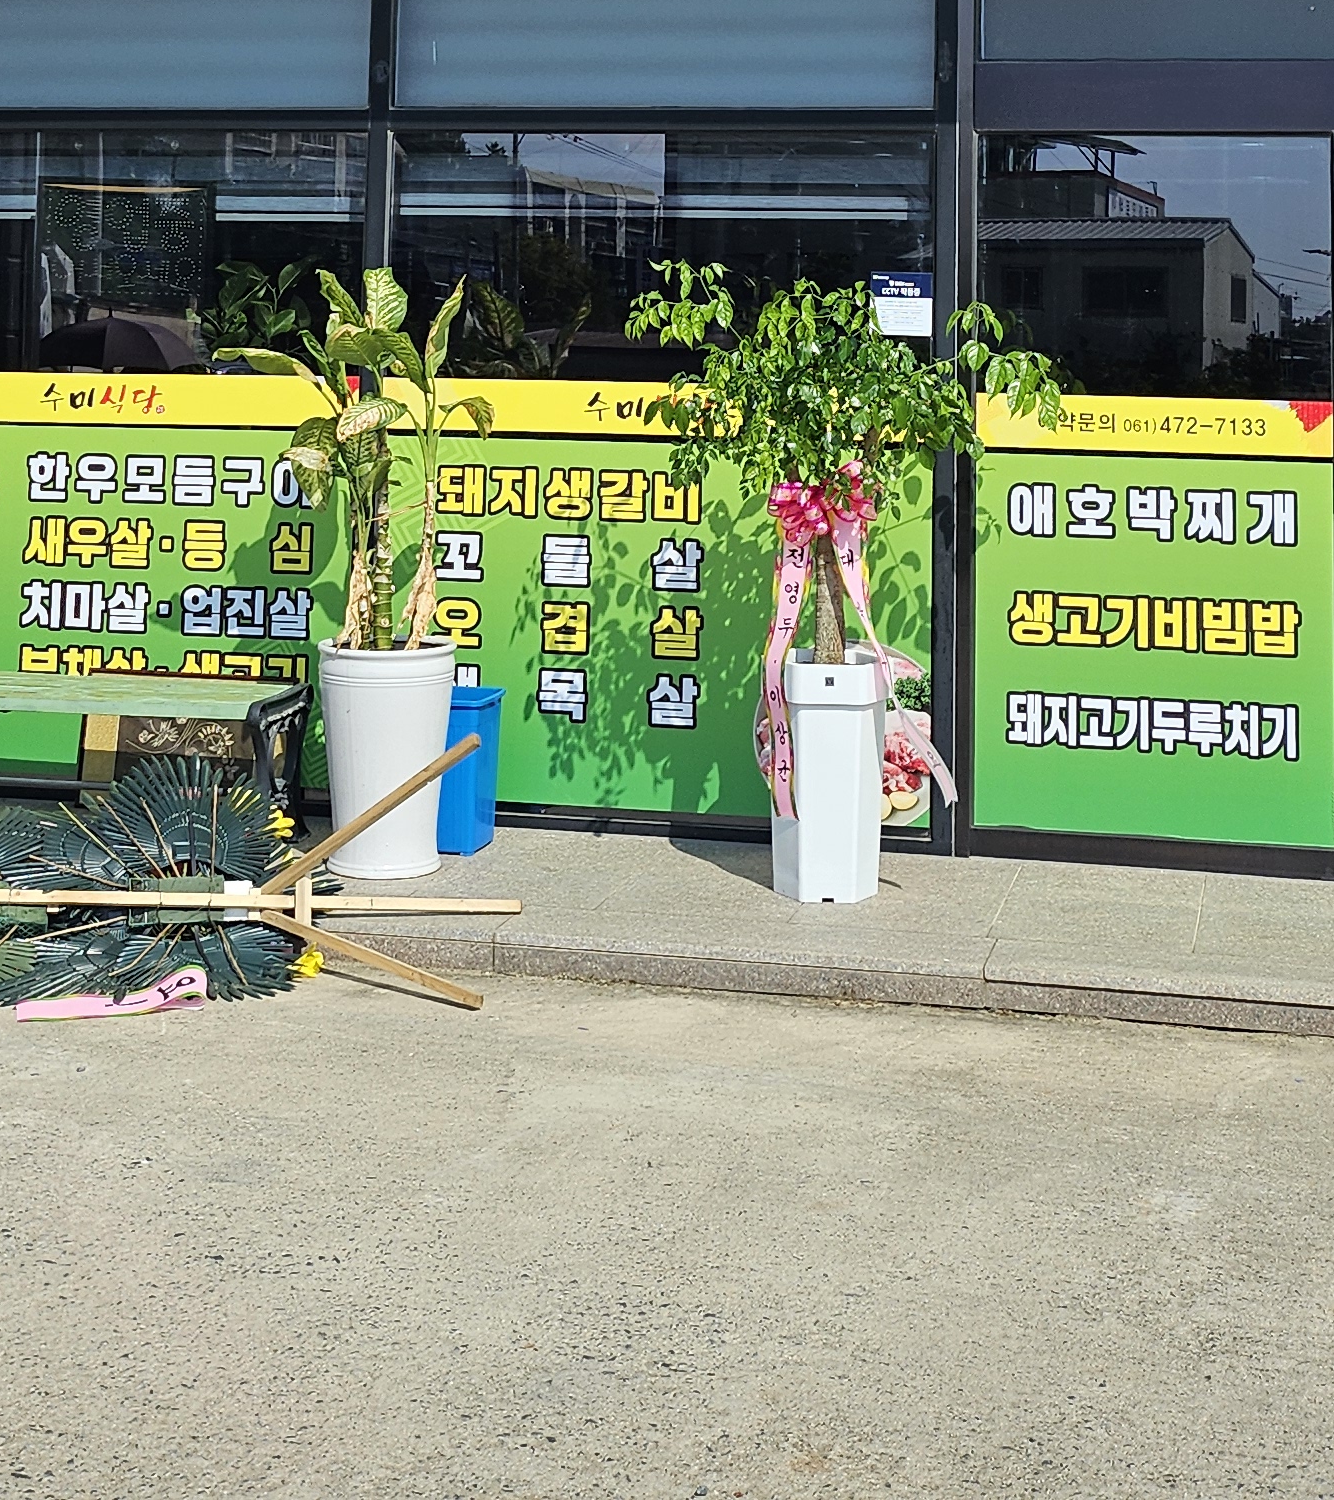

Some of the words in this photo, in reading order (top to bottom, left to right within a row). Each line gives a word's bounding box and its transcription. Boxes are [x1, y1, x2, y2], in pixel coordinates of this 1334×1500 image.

[40, 383, 163, 415] 수미식당
[1038, 411, 1117, 435] 약문의
[435, 464, 703, 525] 돼지생갈비
[1008, 482, 1298, 547] 애호박찌개
[1008, 590, 1302, 658] 생고기비빔밥
[1006, 690, 1300, 762] 돼지고기두루치기
